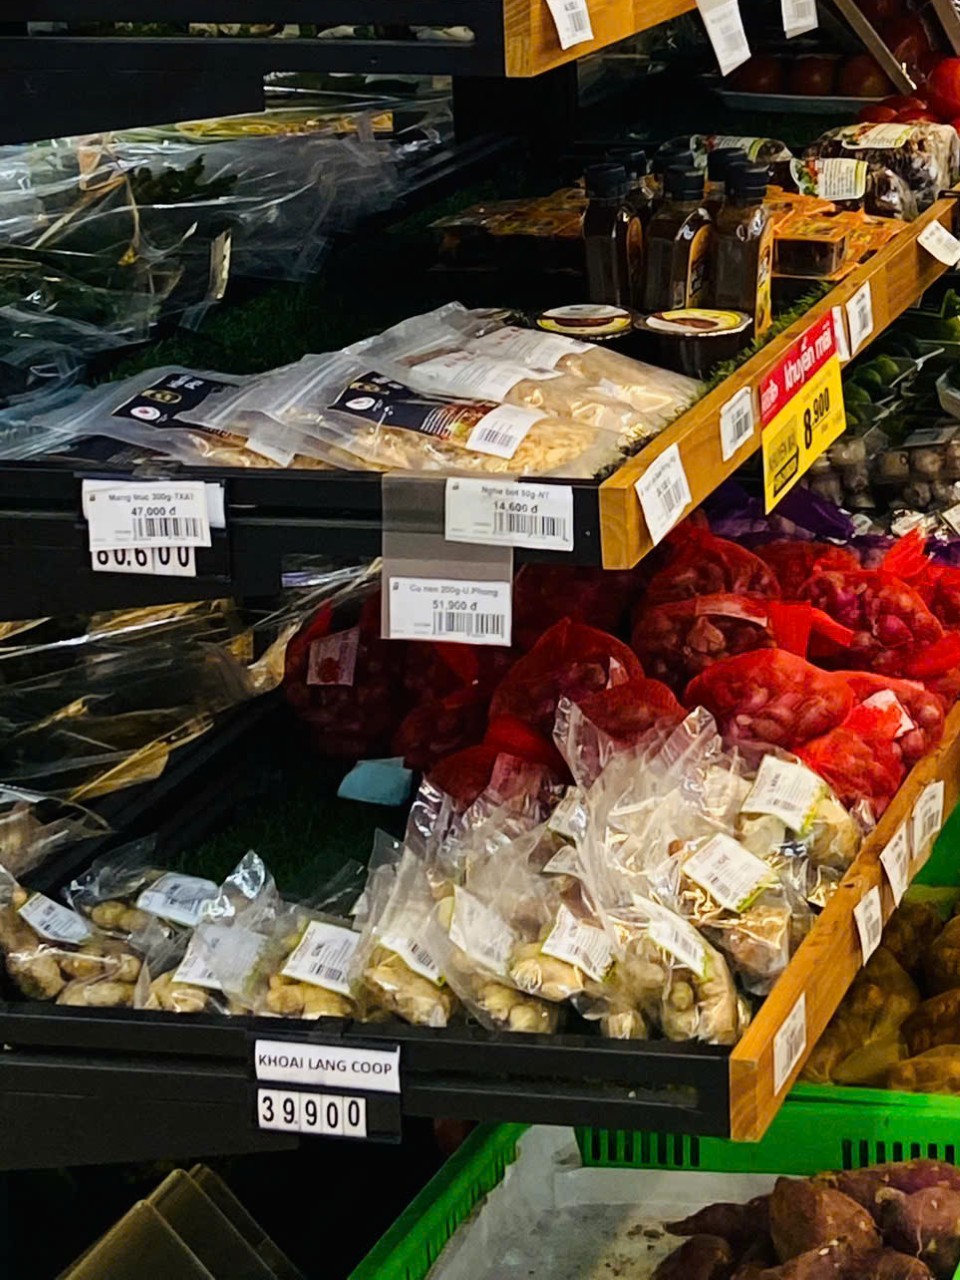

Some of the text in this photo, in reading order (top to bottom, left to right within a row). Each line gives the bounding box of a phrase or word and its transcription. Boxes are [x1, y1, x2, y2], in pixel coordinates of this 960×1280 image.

[258, 1053, 393, 1075] KHOAI LANG COOP
